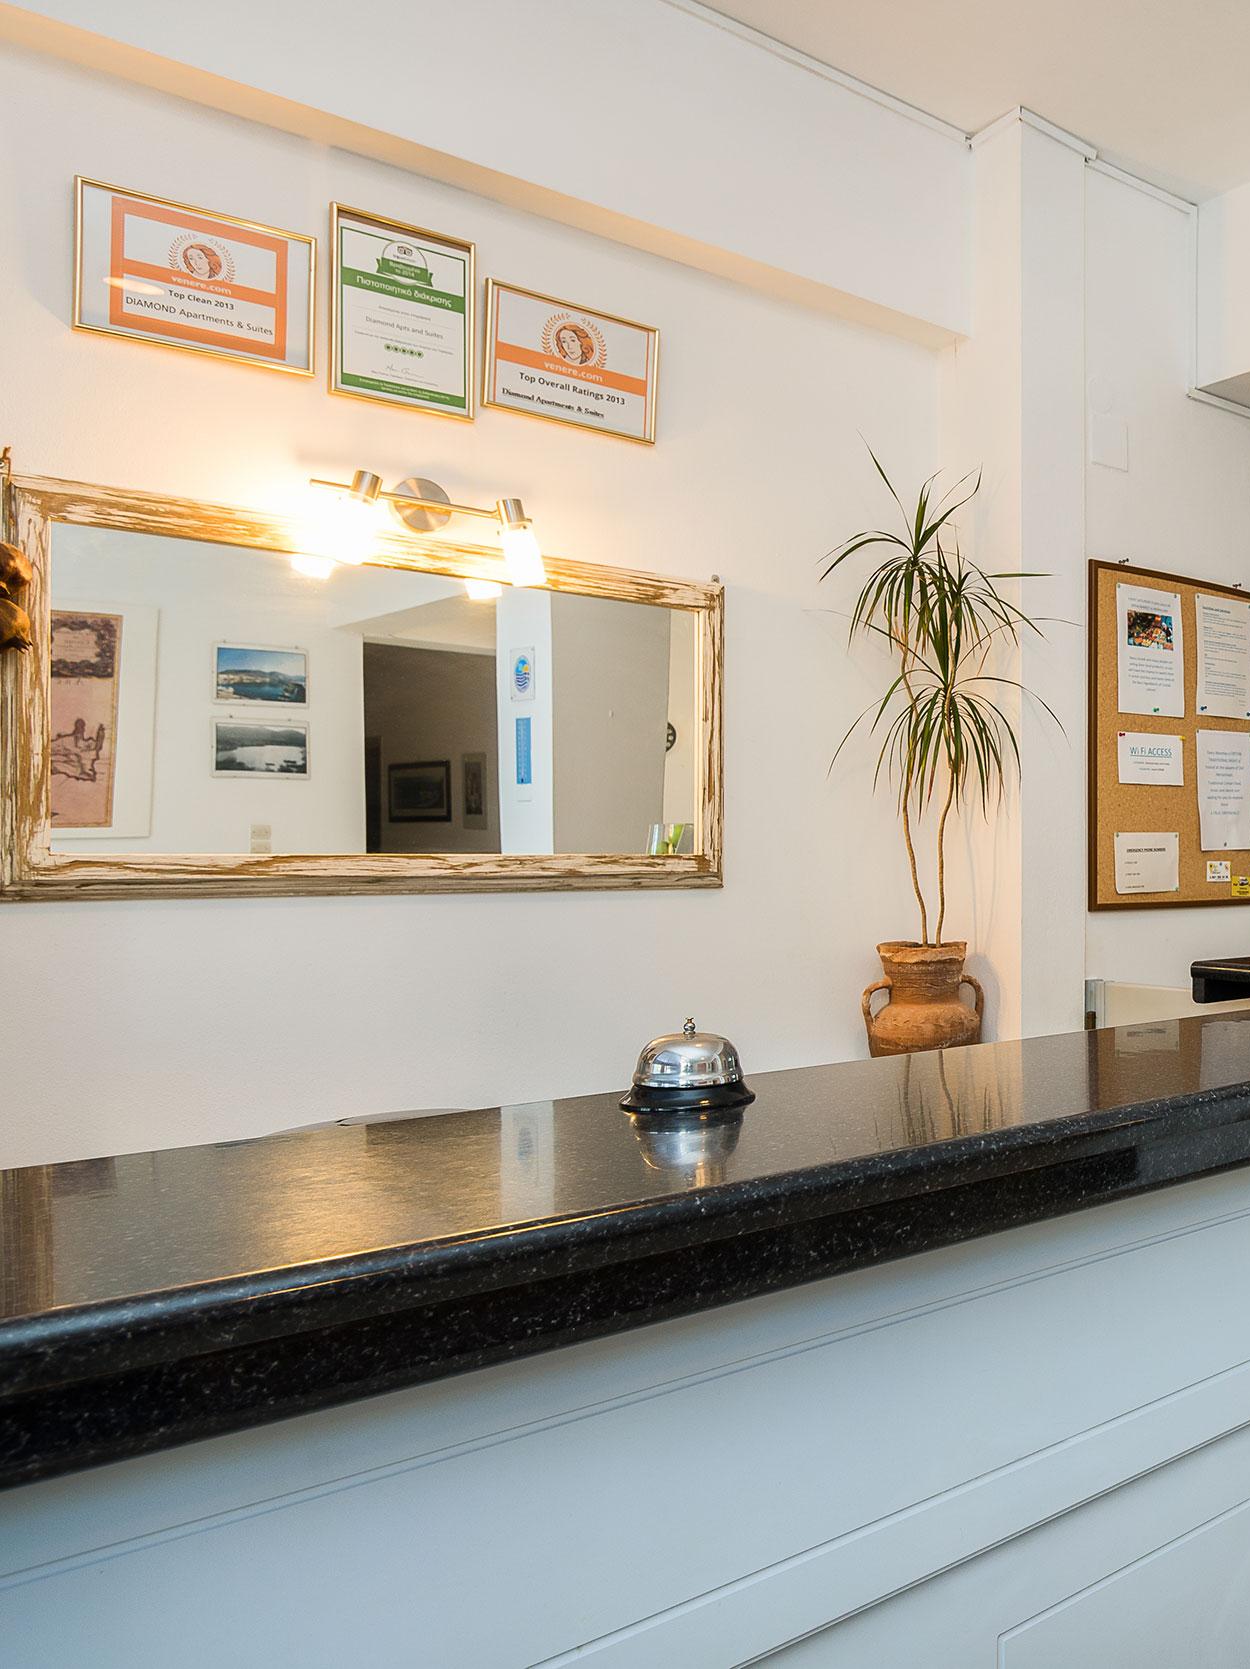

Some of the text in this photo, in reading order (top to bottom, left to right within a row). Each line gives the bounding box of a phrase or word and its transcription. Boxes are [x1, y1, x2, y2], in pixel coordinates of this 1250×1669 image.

[171, 275, 232, 296] venere.com
[356, 275, 452, 308] Πιστοποιητικό διάκρισης
[168, 289, 235, 311] Top Clean 2013
[125, 296, 274, 336] DIAMOND Apartments & Suites
[365, 315, 395, 329] Diamond
[412, 324, 424, 335] and
[424, 327, 444, 340] Suites
[544, 361, 603, 383] venere.com
[502, 387, 535, 402] Diamond
[535, 396, 575, 411] Apartments
[576, 405, 583, 414] &
[519, 372, 625, 405] Top Overall Ratings 2013
[1148, 747, 1173, 757] ACCESS
